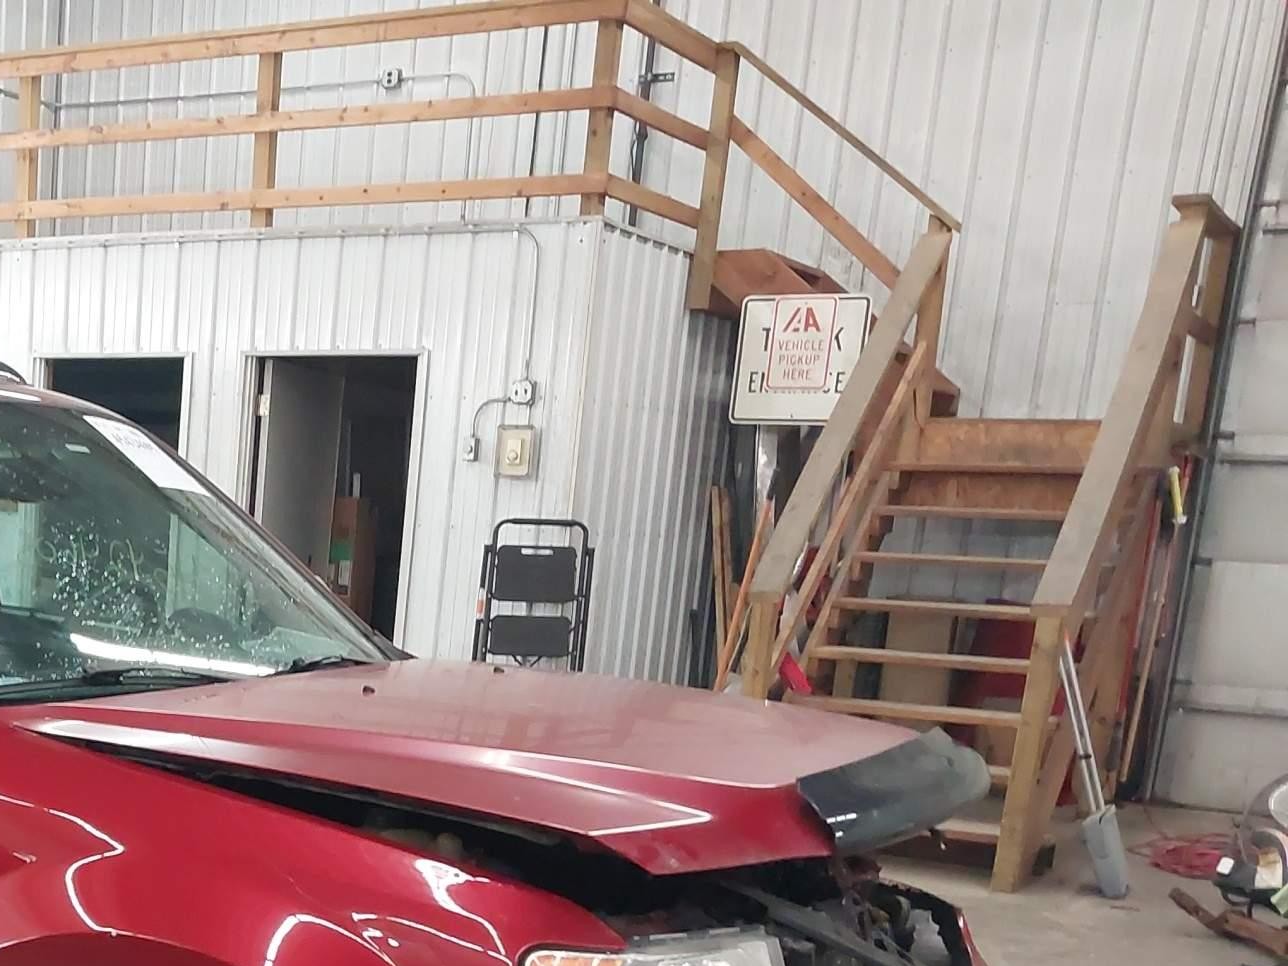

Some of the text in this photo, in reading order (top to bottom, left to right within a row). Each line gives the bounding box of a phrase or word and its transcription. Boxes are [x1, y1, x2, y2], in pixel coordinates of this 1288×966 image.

[778, 339, 824, 352] VEHICLE
[778, 354, 820, 366] PICKUP
[782, 368, 811, 381] HERE
